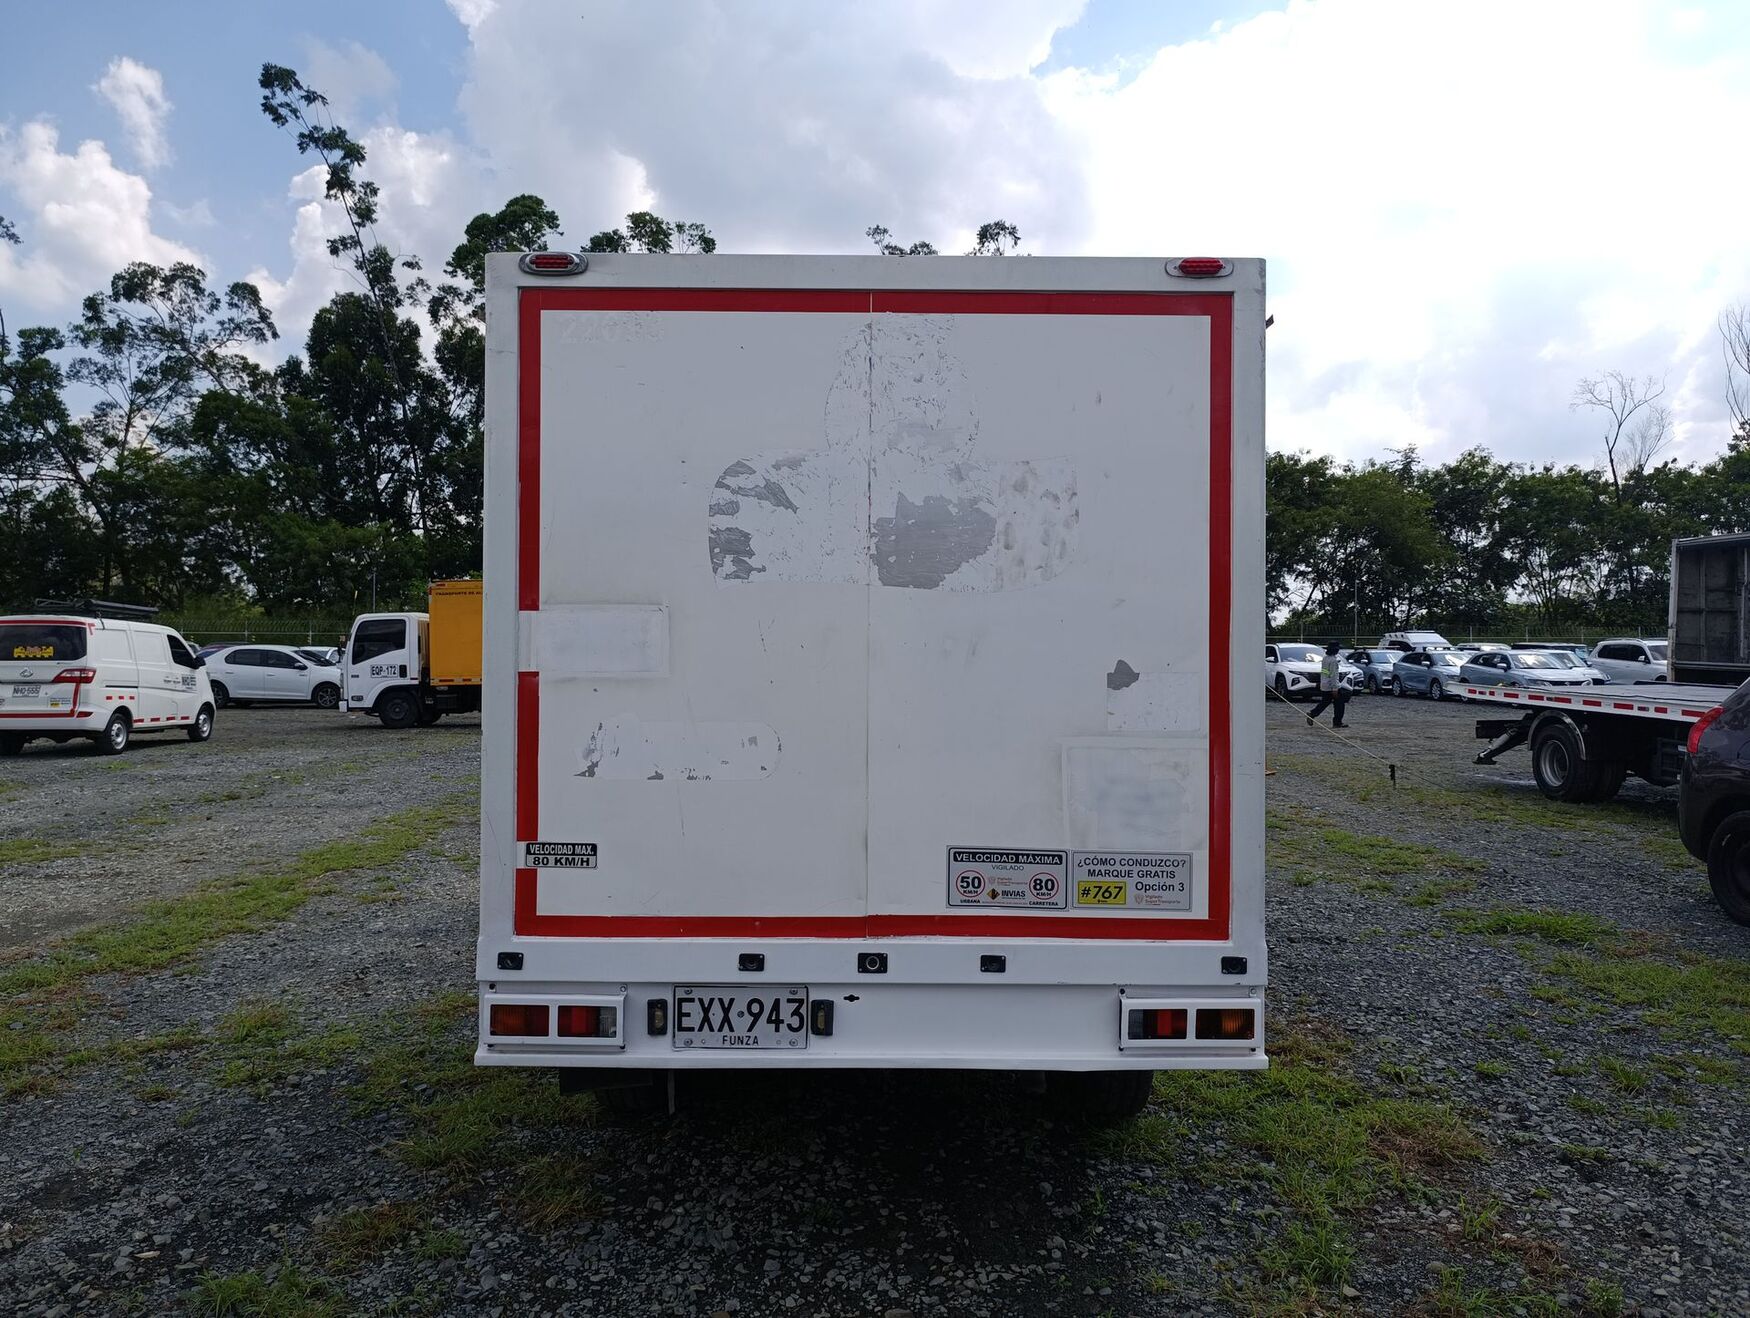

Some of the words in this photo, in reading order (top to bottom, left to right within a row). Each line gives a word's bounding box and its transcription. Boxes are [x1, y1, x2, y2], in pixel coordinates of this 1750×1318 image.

[529, 844, 573, 855] VELOCIDAD
[574, 845, 594, 855] MAX.
[532, 856, 550, 866] 80
[554, 857, 590, 867] KM/H
[955, 853, 1016, 863] VELOCIDAD
[1018, 853, 1061, 864] MÁXIMA
[1077, 855, 1117, 868] ¿CÓMO
[1119, 858, 1186, 868] CONDUZCO?
[1087, 868, 1134, 879] MARQUE
[1136, 870, 1176, 879] GRATIS
[960, 876, 982, 889] 50
[1032, 878, 1055, 892] 80
[1135, 881, 1175, 893] Opción
[1178, 882, 1185, 892] 3
[1001, 889, 1026, 898] INVIAS
[1080, 885, 1124, 900] #767
[722, 1035, 759, 1046] FUNZA
